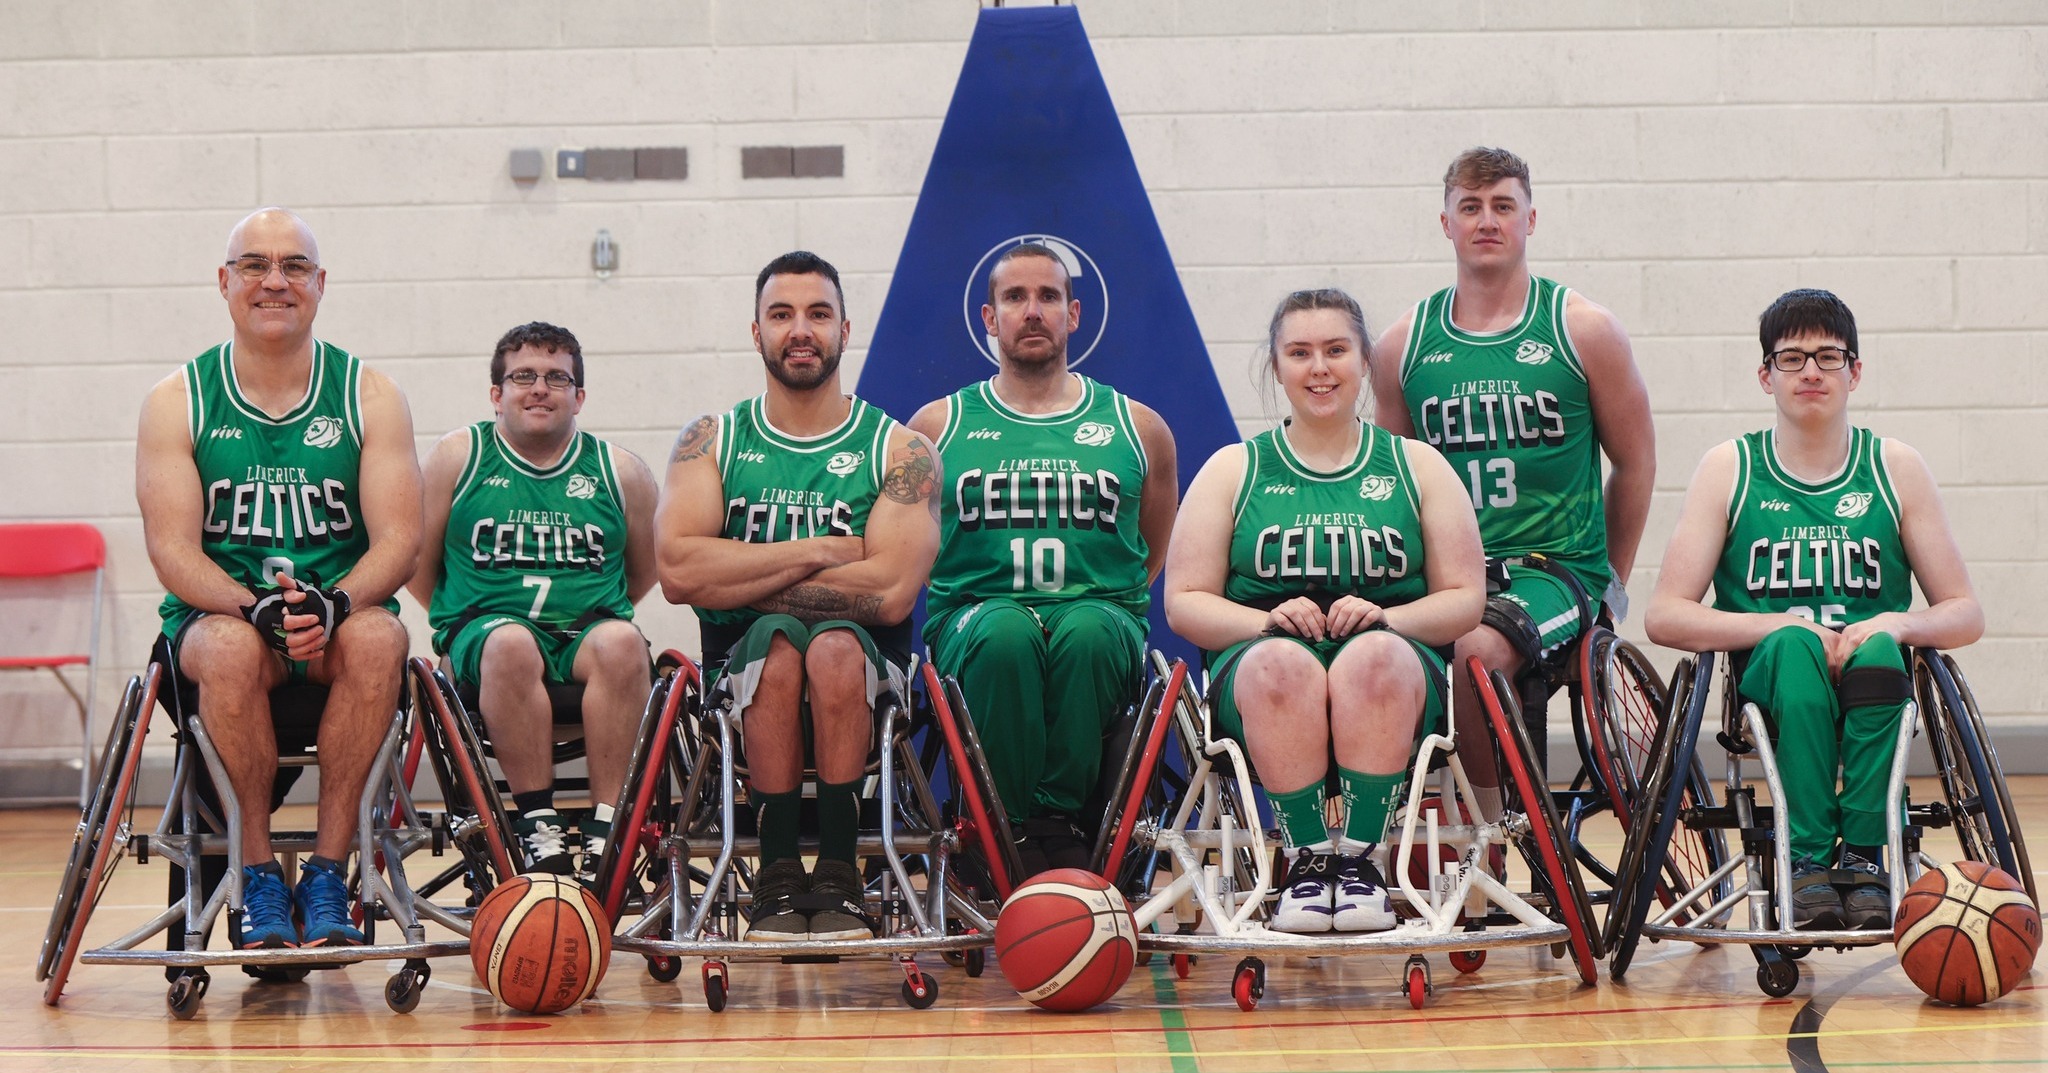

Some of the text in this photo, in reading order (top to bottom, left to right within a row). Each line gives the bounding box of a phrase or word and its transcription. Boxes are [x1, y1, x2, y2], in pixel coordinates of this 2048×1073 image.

[1451, 380, 1522, 397] LIMERICK
[1421, 390, 1566, 453] CELTICS
[246, 465, 309, 484] LIMERICK
[997, 458, 1081, 472] LIMERICK
[1467, 457, 1518, 509] 13
[203, 477, 354, 549] CELTICS
[507, 509, 573, 526] LIMERICK
[759, 487, 825, 506] LIMERICK
[956, 468, 1121, 534] CELTICS
[1294, 512, 1368, 528] LIMERICK
[470, 517, 606, 574] CELTICS
[1254, 524, 1408, 586] CELTICS
[1782, 525, 1850, 540] LIMERICK
[1010, 537, 1065, 592] 10
[1746, 536, 1882, 600] CELTICS
[522, 575, 552, 620] 7
